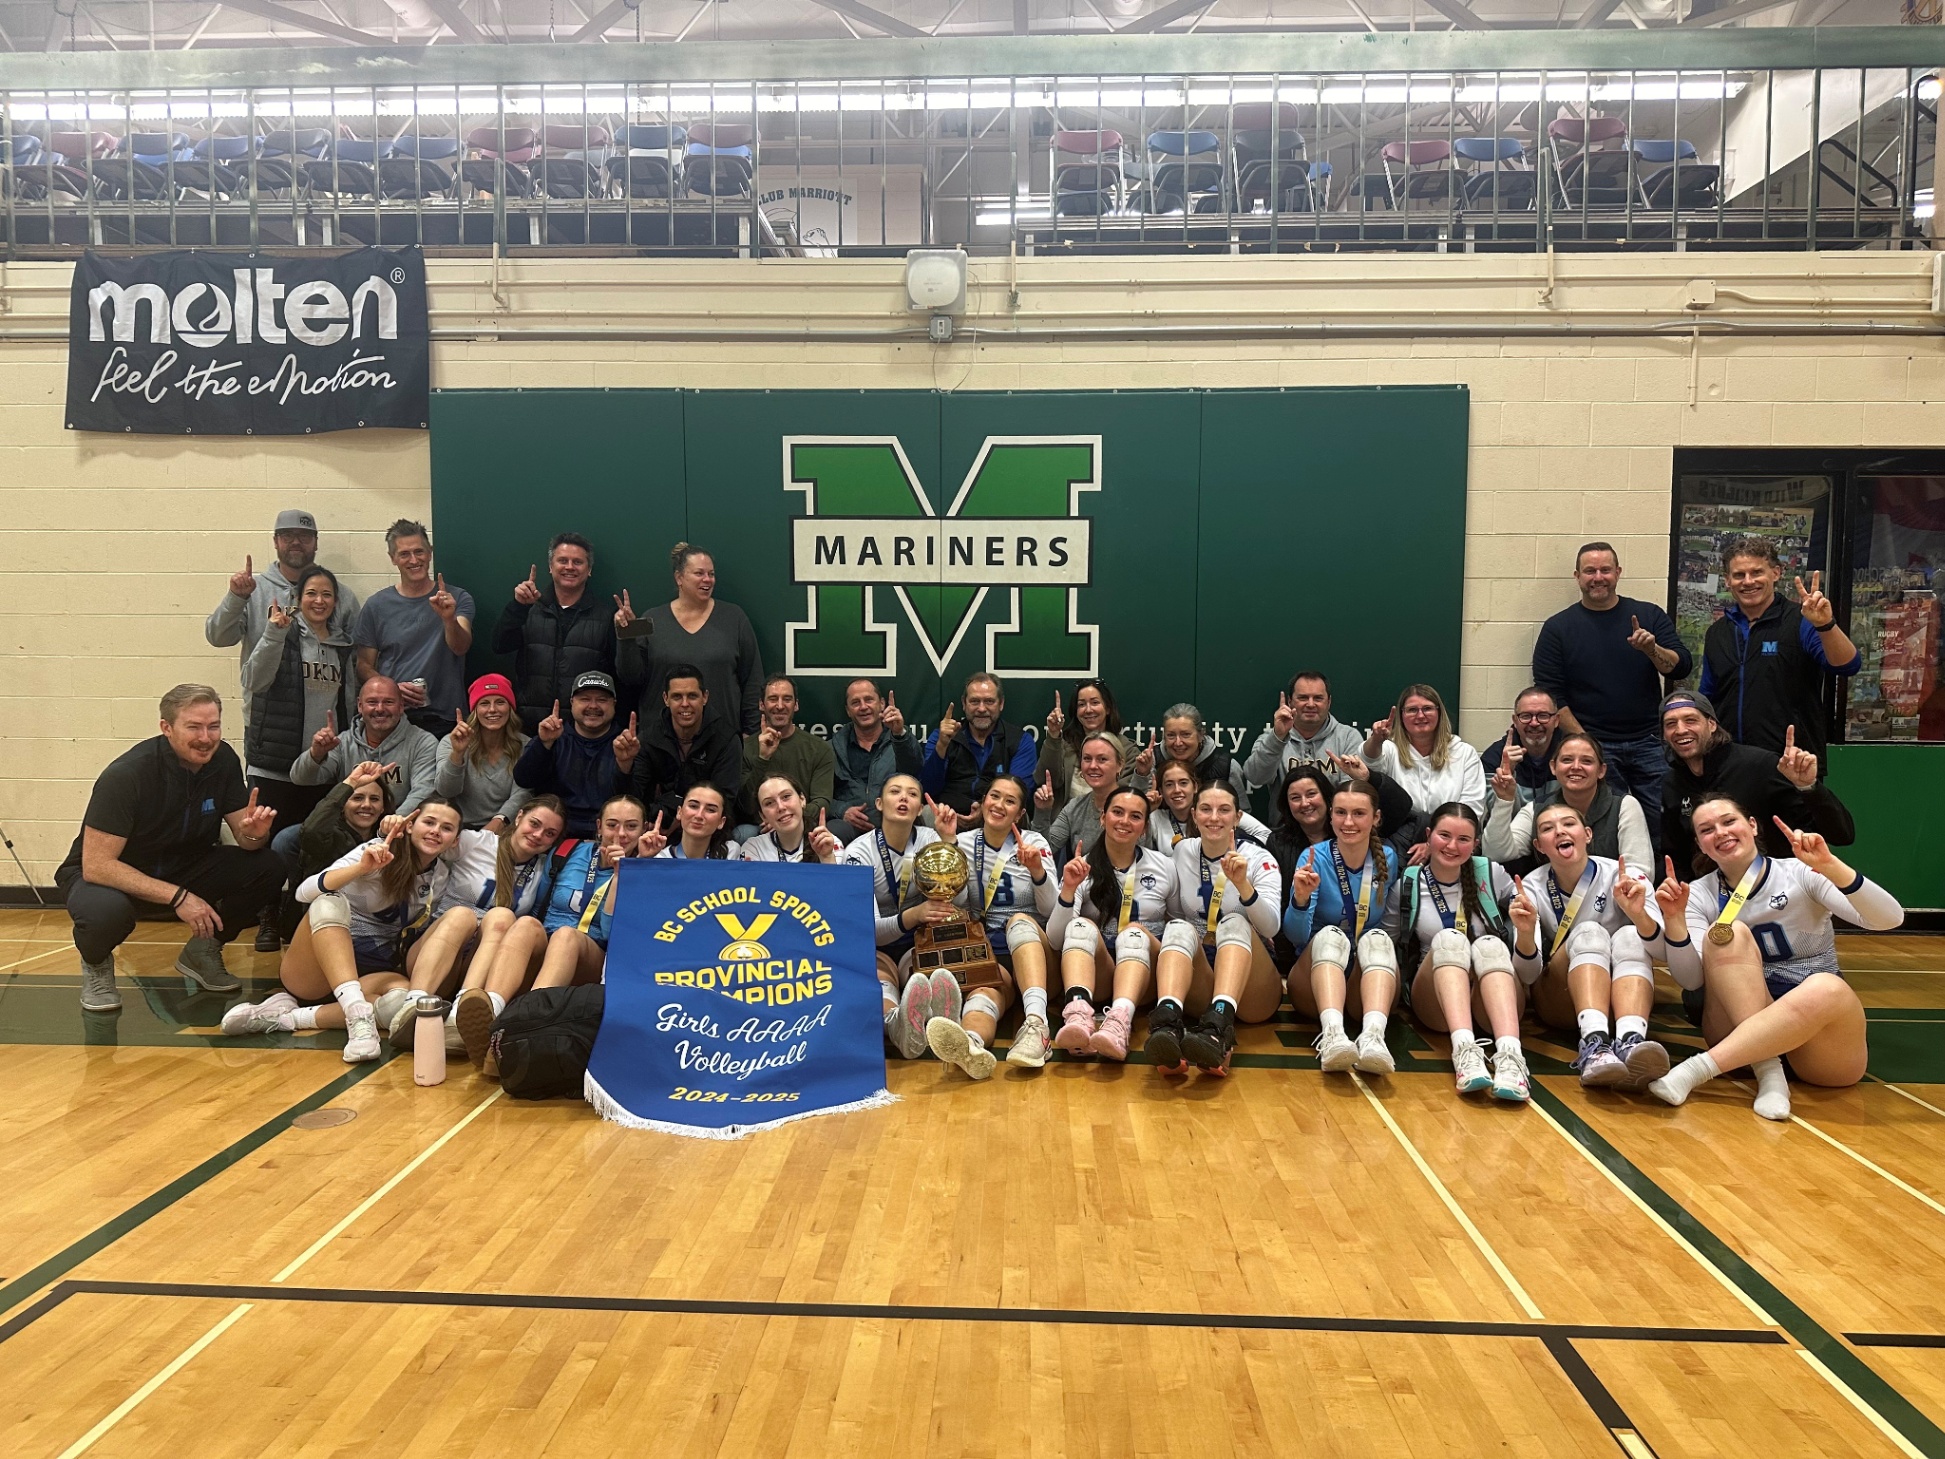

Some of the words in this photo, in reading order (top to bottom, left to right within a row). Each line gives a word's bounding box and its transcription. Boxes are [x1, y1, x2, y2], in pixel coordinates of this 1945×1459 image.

[759, 189, 785, 206] LUB
[91, 346, 178, 404] feel
[175, 359, 242, 401] the
[782, 434, 1102, 678] M
[814, 535, 1069, 567] MARINERS
[653, 920, 683, 943] BC
[676, 886, 761, 924] SCHOOL
[769, 890, 835, 947] SPORTS
[654, 958, 832, 990] PROVINCIAL
[655, 1003, 721, 1039] Girls
[674, 1040, 808, 1080] Volleyball
[668, 1086, 801, 1103] 2024-2025
